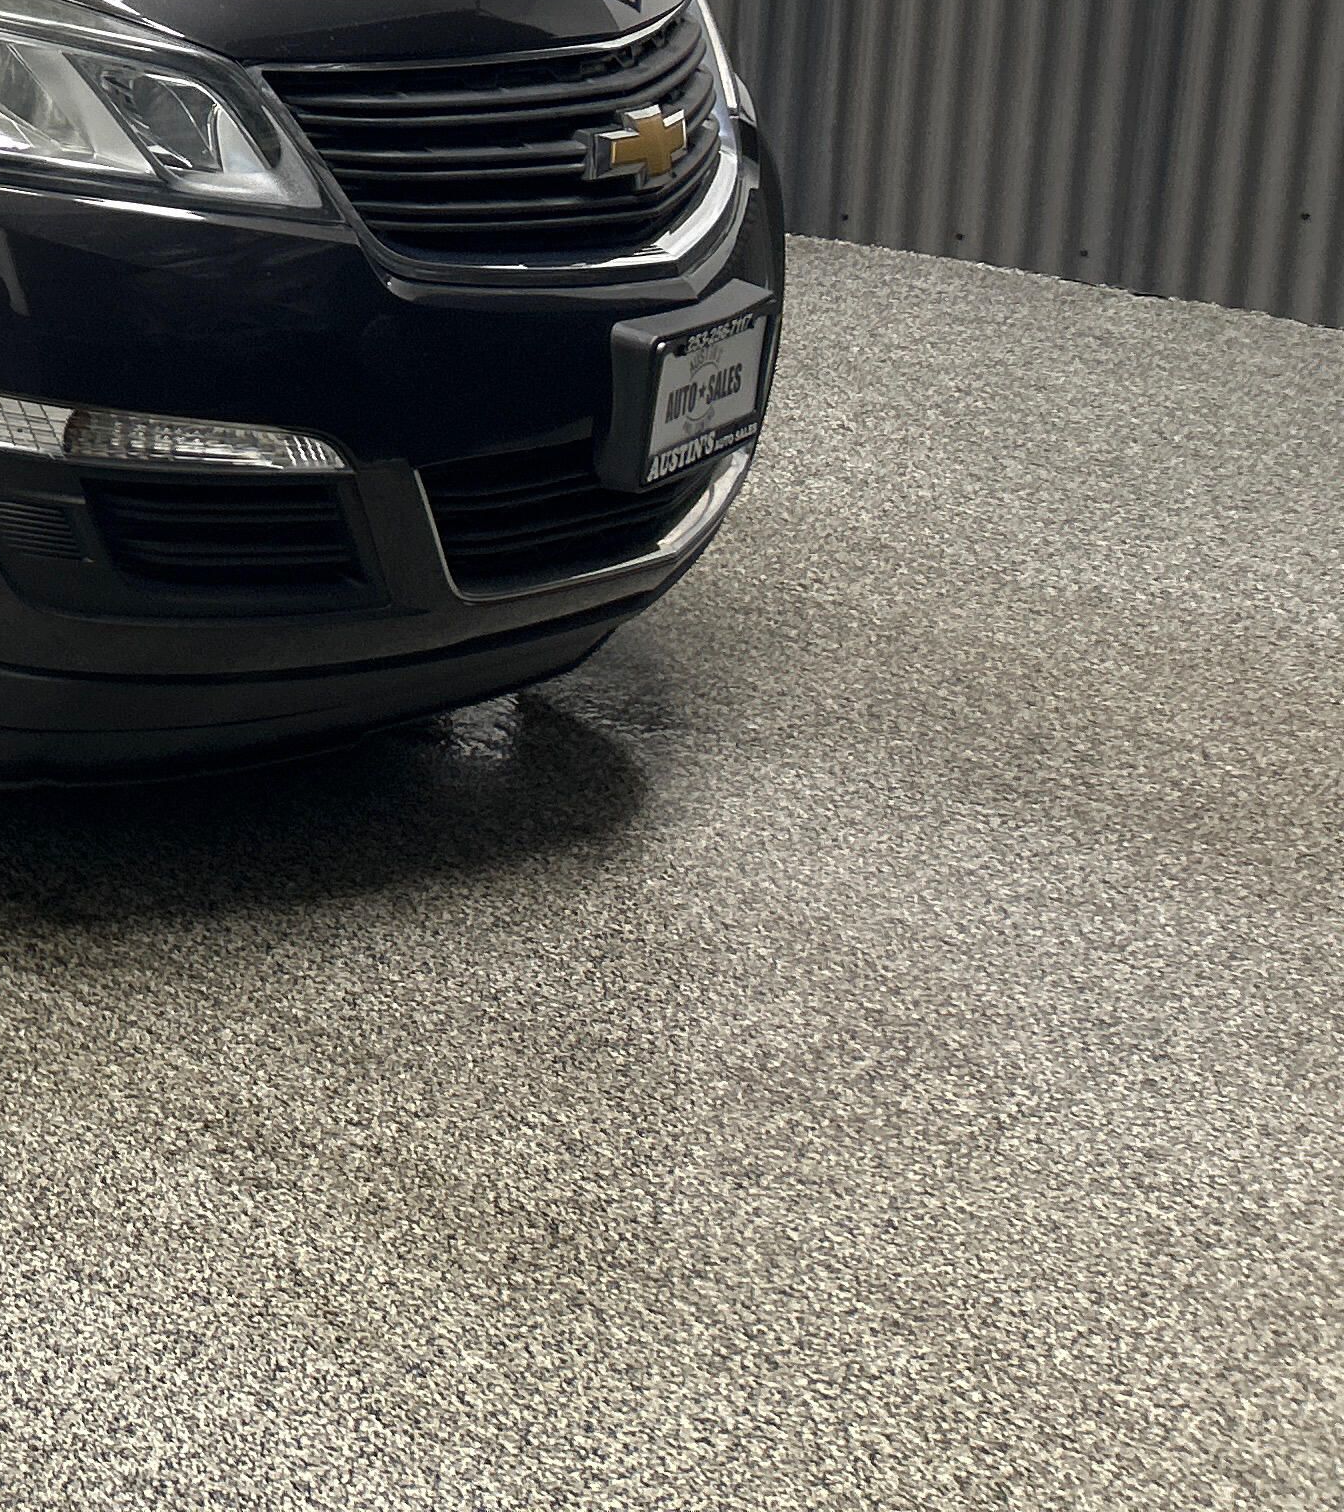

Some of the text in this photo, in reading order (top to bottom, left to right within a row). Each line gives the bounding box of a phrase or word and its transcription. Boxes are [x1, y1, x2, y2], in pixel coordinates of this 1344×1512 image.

[665, 382, 698, 424] AUTO
[706, 363, 743, 405] SALES
[646, 431, 716, 482] AUSTIN'S
